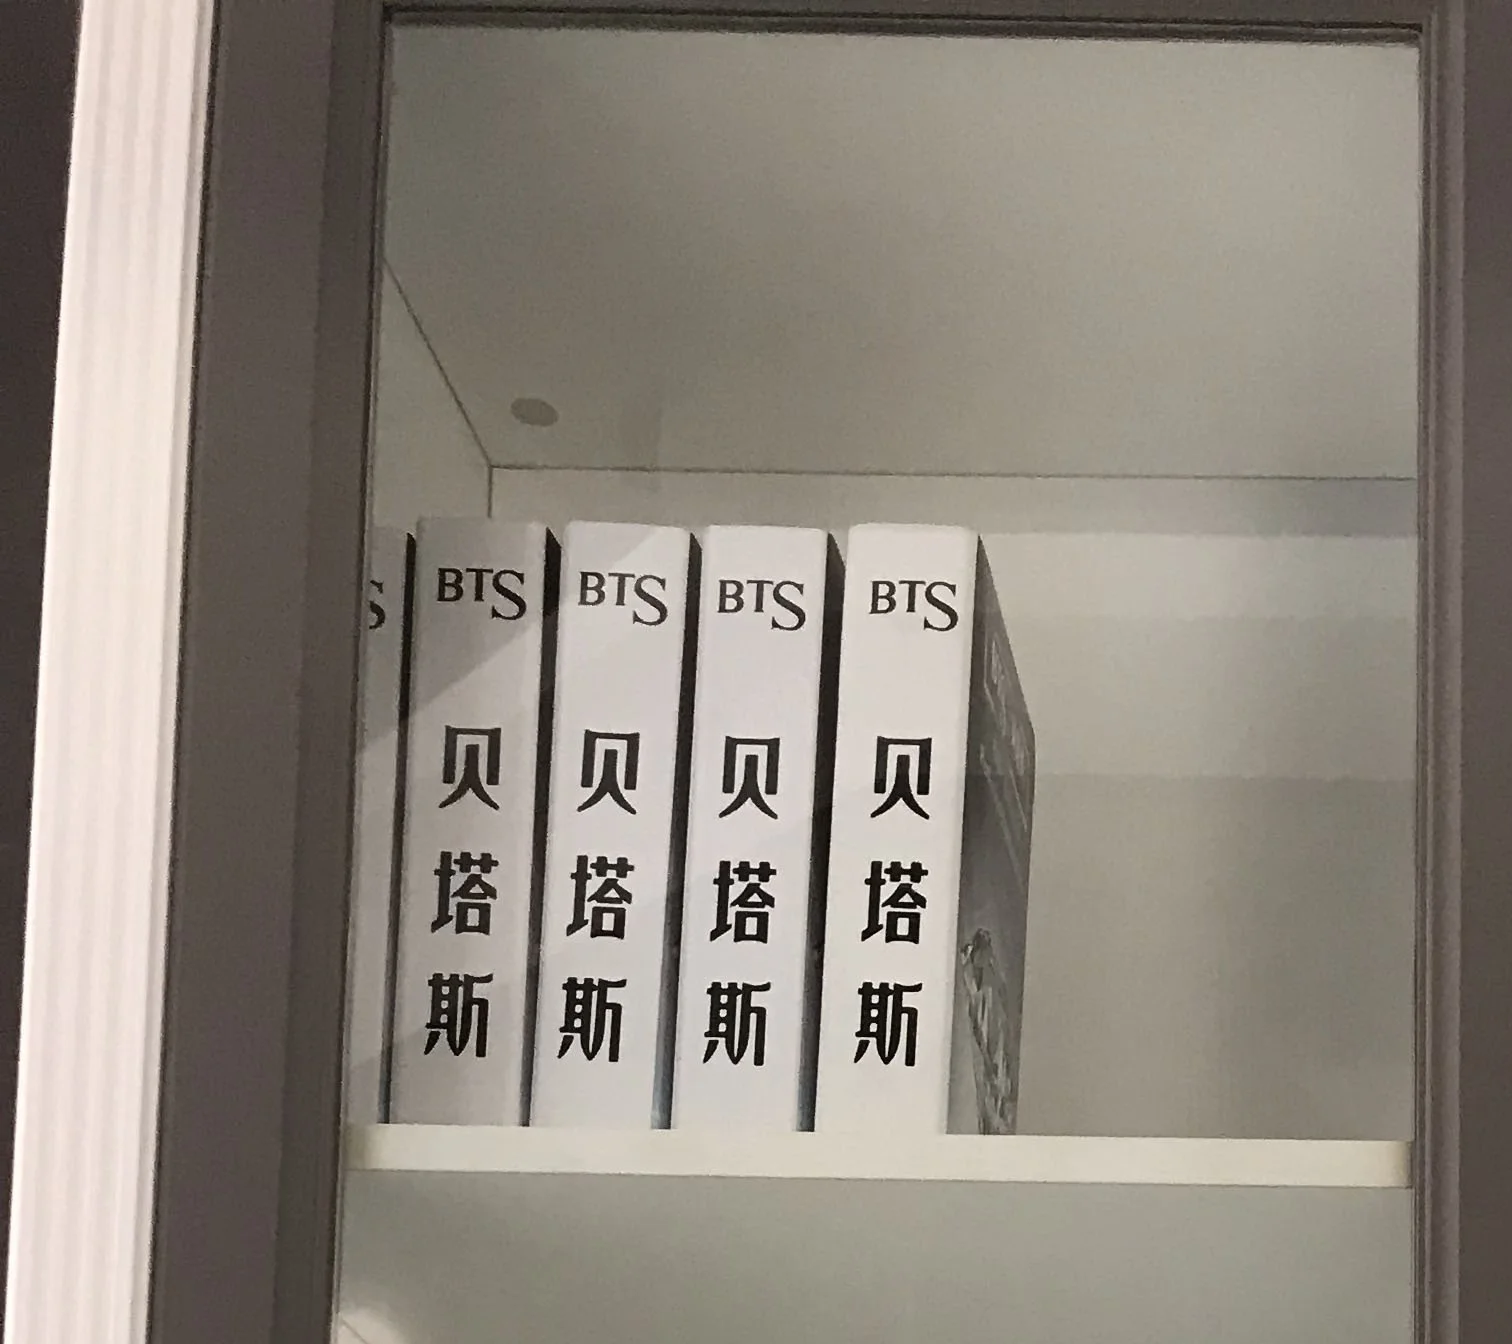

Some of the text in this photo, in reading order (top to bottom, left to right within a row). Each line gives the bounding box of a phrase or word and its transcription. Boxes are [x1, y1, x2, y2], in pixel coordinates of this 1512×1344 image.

[437, 568, 526, 620] BTS
[578, 571, 668, 626] BTS
[718, 579, 806, 631] BTS
[868, 580, 959, 631] BTS
[423, 725, 502, 1057] 贝塔斯
[557, 730, 640, 1062] 贝塔斯
[703, 736, 781, 1066] 贝塔斯
[853, 736, 933, 1066] 贝塔斯
